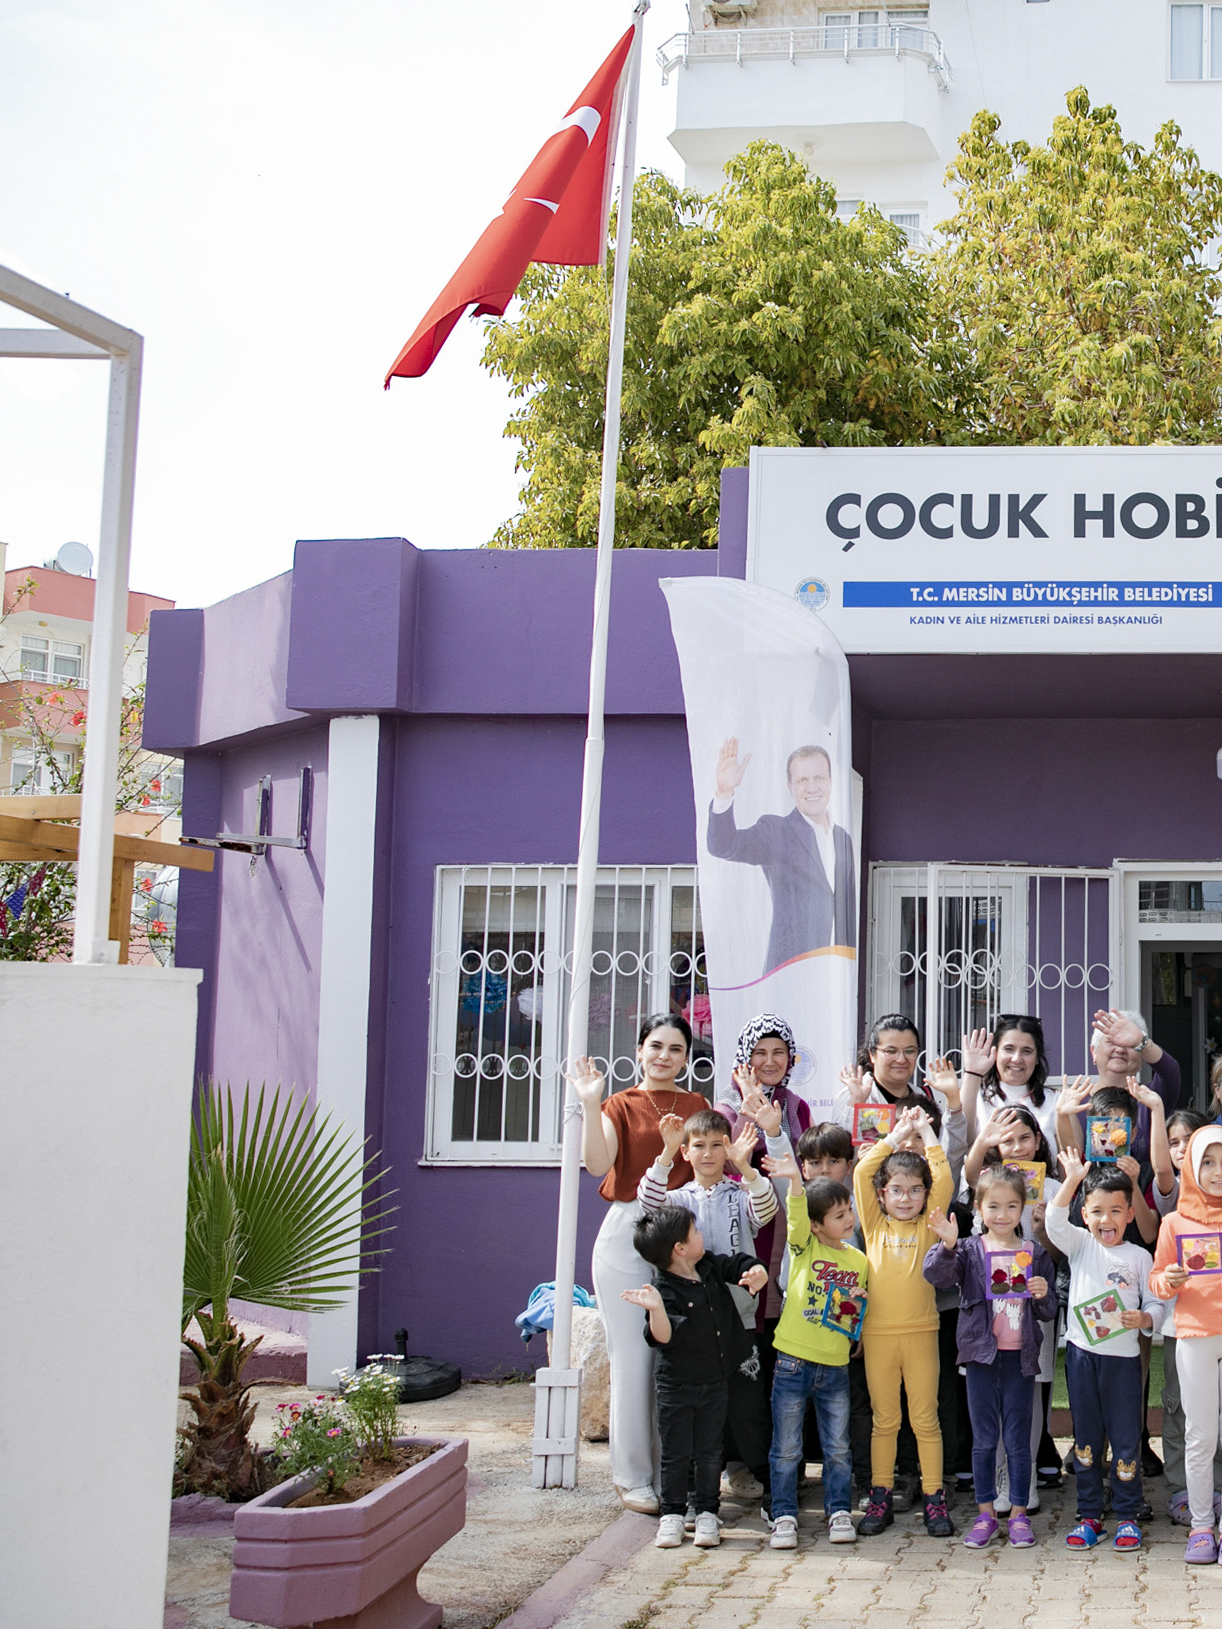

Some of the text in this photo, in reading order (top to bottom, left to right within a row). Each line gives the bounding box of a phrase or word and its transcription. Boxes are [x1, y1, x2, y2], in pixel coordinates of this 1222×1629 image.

[826, 492, 1049, 552] ÇOCUK
[910, 583, 1213, 605] T.C. MERSİN BÜYÜKŞEHİR BELEDİYESİ
[910, 613, 1163, 626] KADIN VE AİLE HİZMETLERİ DAİRESİ BAŞKANLIĞI
[811, 1260, 859, 1286] Team
